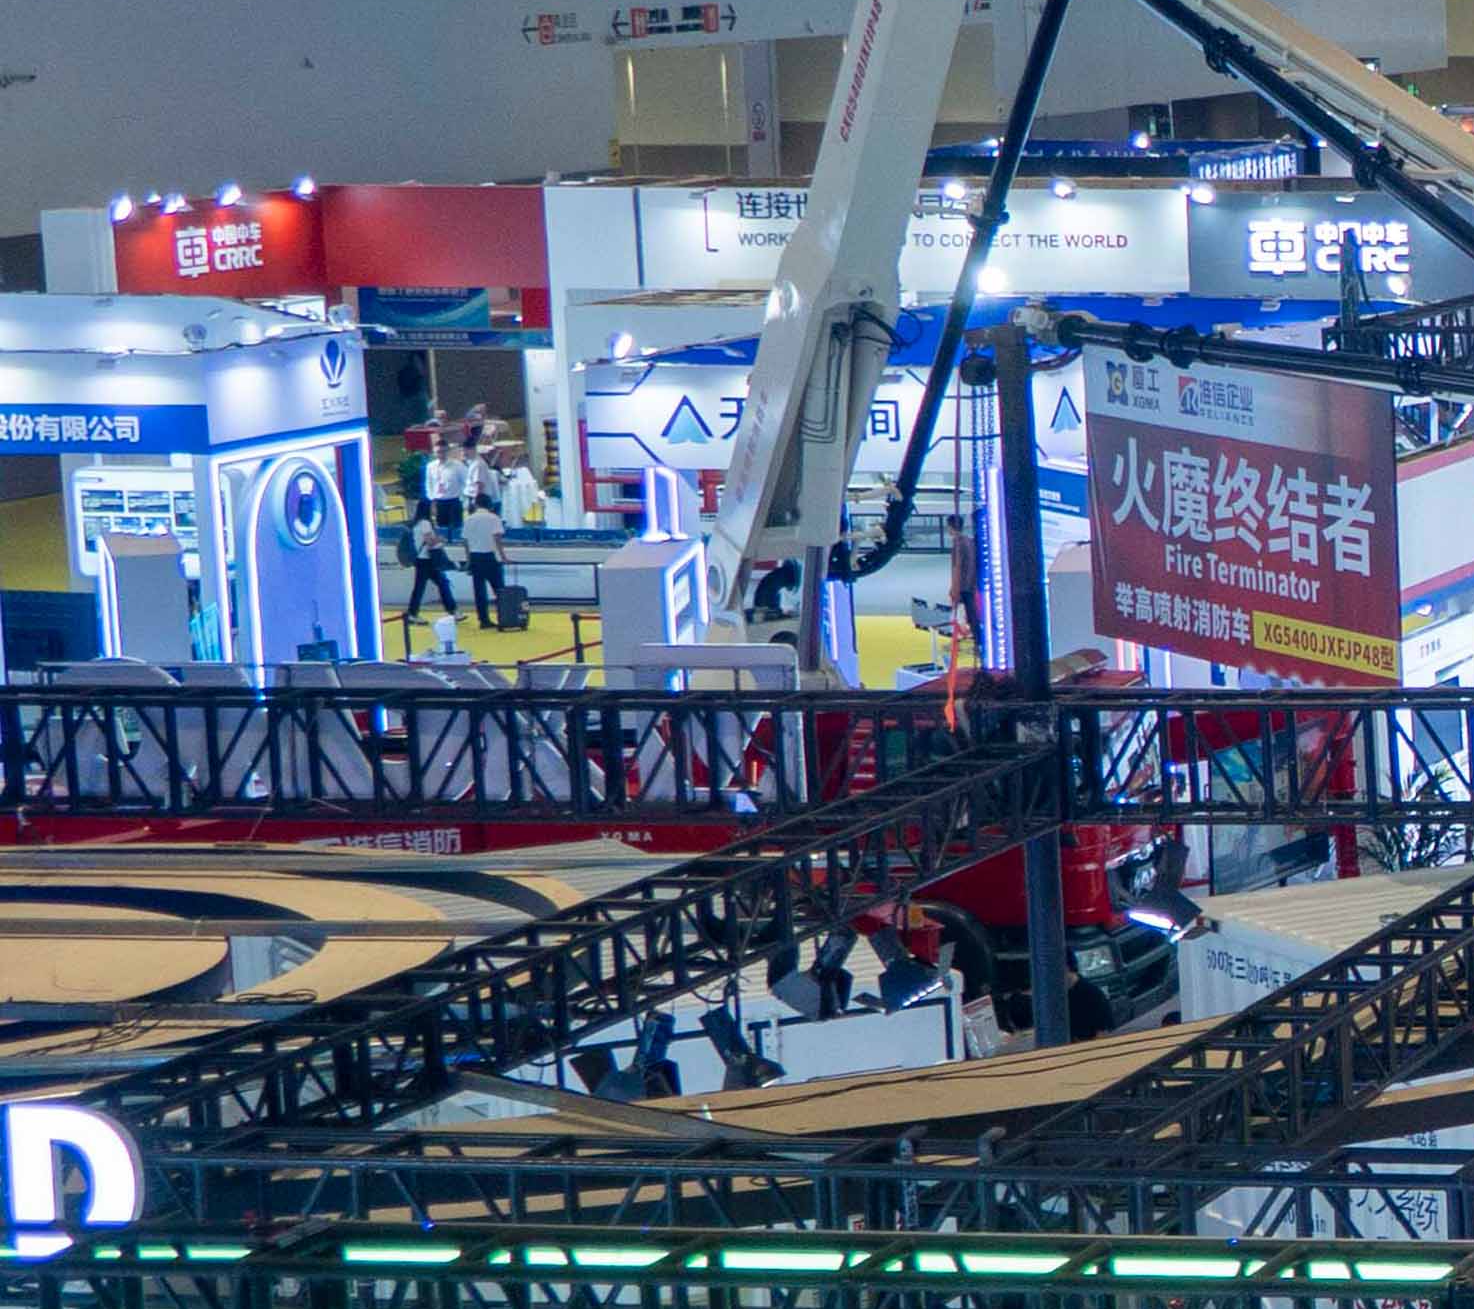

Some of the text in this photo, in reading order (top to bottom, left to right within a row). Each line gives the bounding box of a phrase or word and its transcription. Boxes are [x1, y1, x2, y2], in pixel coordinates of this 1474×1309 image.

[212, 223, 262, 246] 中国中车
[914, 233, 934, 248] TO
[939, 233, 1021, 248] CONECT
[1028, 235, 1060, 249] THE
[1065, 235, 1128, 249] WORLD
[214, 245, 263, 271] CRRC
[1315, 246, 1410, 273] CRC
[1112, 437, 1375, 578] 火魔终结者
[1165, 545, 1320, 604] Fire Terminator
[1115, 581, 1251, 645] 举高喷射消防车
[1263, 621, 1394, 673] XG5400JXFJP48型
